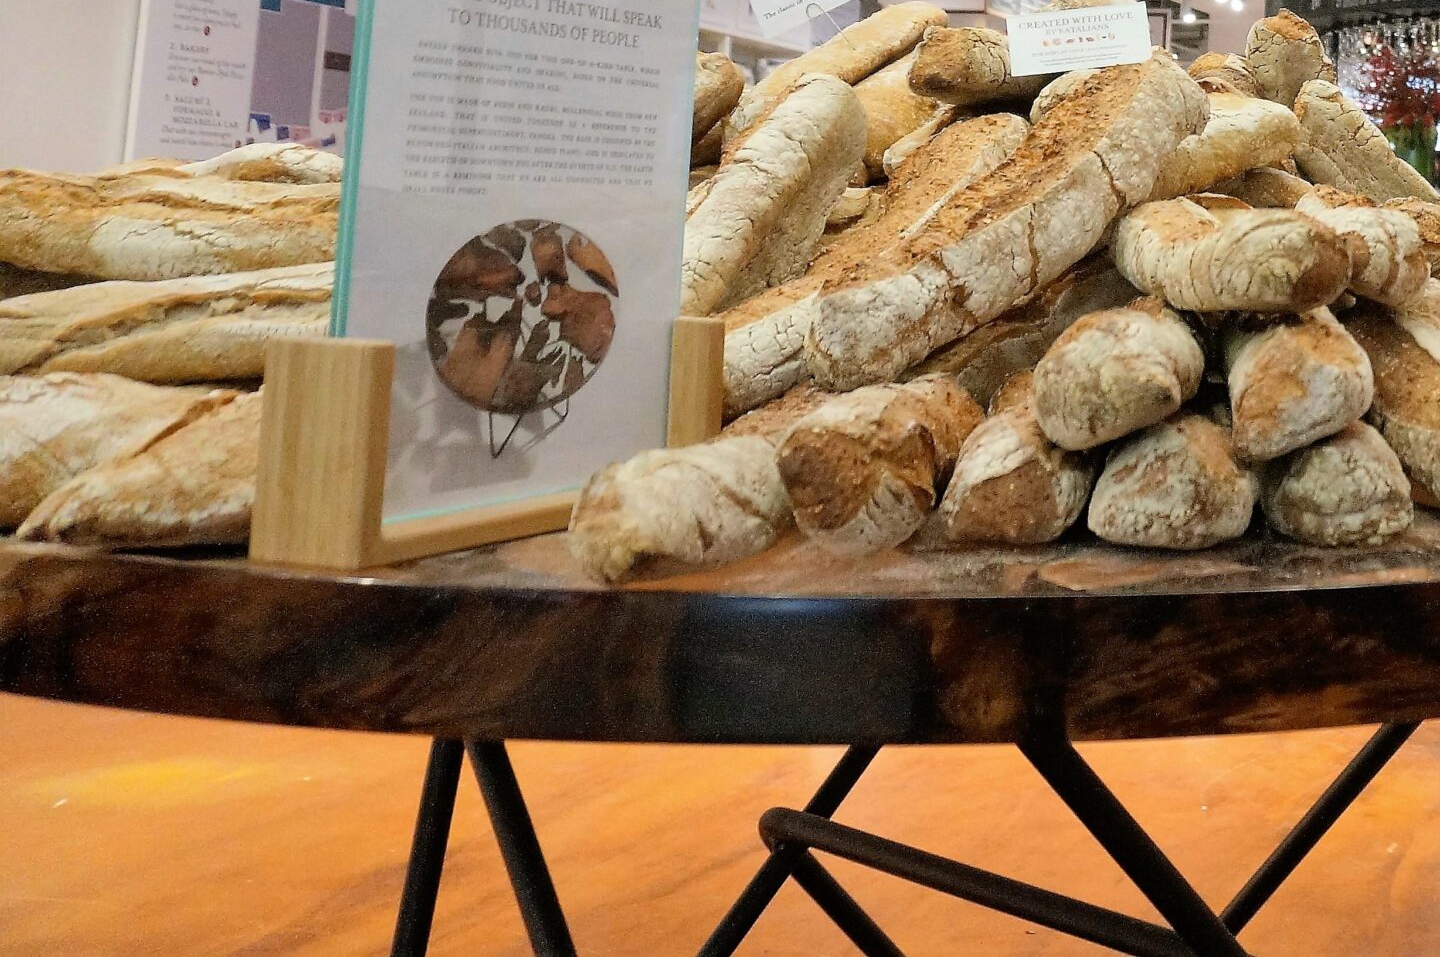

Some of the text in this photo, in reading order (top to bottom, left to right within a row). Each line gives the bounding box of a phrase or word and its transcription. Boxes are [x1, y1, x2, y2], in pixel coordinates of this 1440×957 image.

[587, 4, 620, 24] WILL
[623, 10, 663, 29] SPEAK
[764, 10, 776, 21] The
[1018, 10, 1134, 30] CREATED WITH LOVE
[448, 7, 641, 49] TO THOUSANDS OF PEOPLE
[1045, 22, 1110, 36] BY EATALIANS
